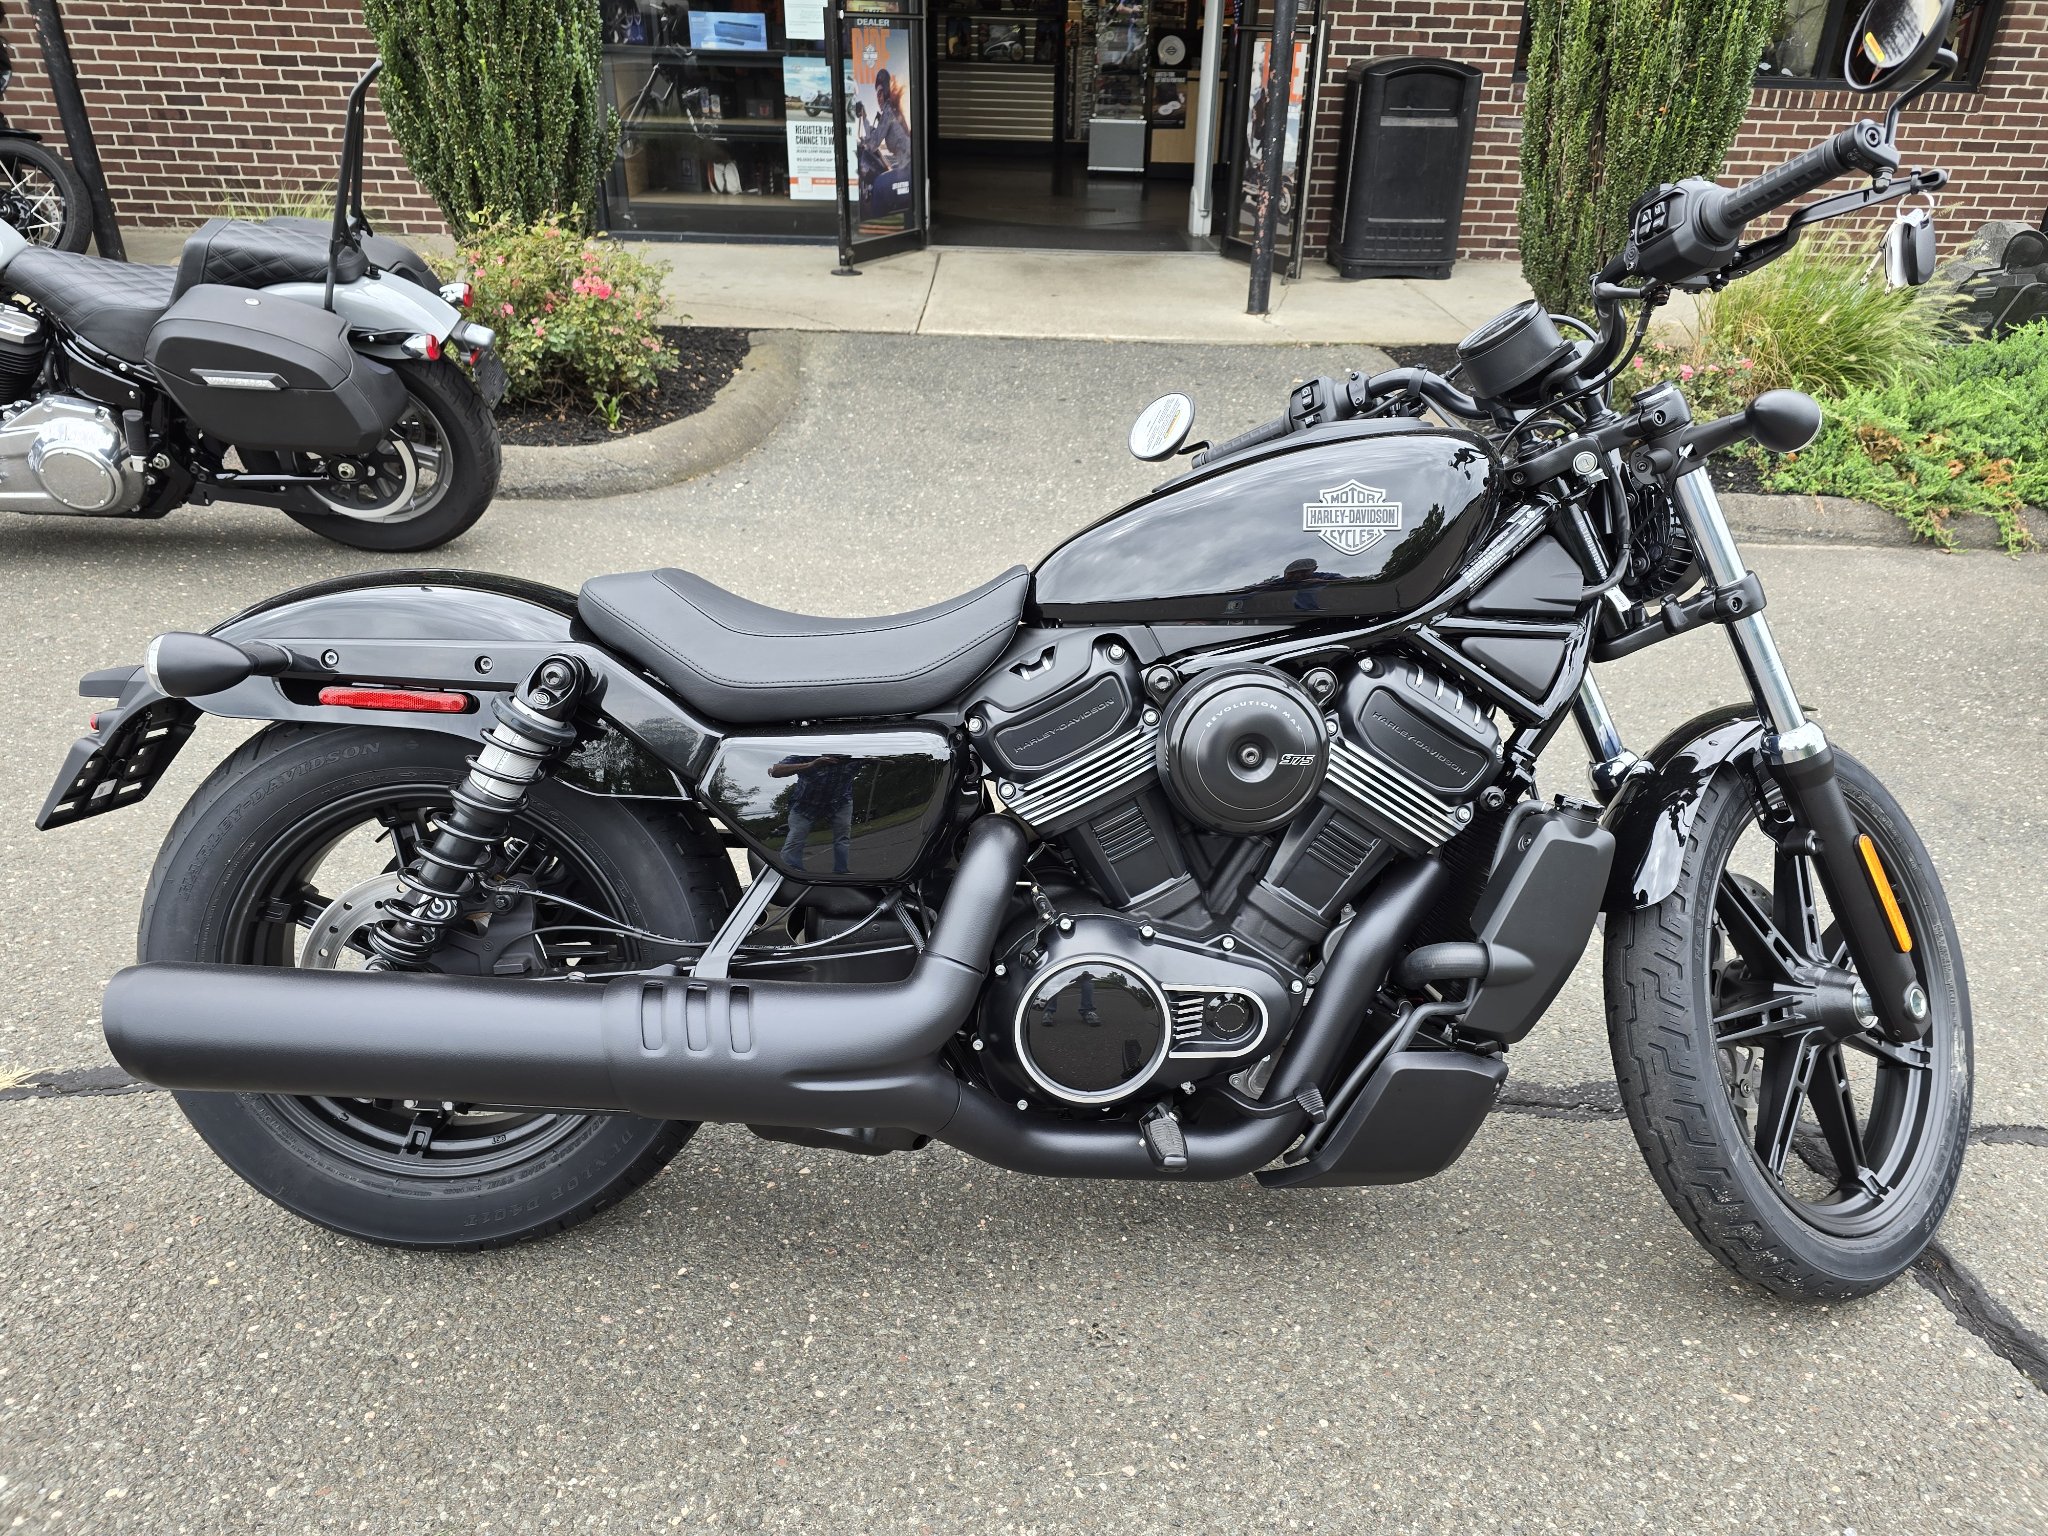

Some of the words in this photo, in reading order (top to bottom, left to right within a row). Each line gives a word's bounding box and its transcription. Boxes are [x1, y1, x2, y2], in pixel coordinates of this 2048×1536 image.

[856, 18, 890, 27] DEALER
[795, 125, 822, 135] REGISTER
[795, 135, 819, 146] CHANCE
[820, 136, 828, 146] TO
[1330, 486, 1376, 504] MOTOR
[1310, 508, 1395, 525] HARLEY-DAVIDSON
[1329, 529, 1377, 549] CYCLES
[1205, 700, 1278, 729] REVOLUTION
[1282, 711, 1302, 732] MAX
[1010, 697, 1115, 754] HARLEY-DAVIDSON
[1371, 711, 1468, 776] HARLEY-DAVIDSON
[1278, 753, 1316, 766] 975
[178, 742, 381, 902] HARLEY-DAVIDSON
